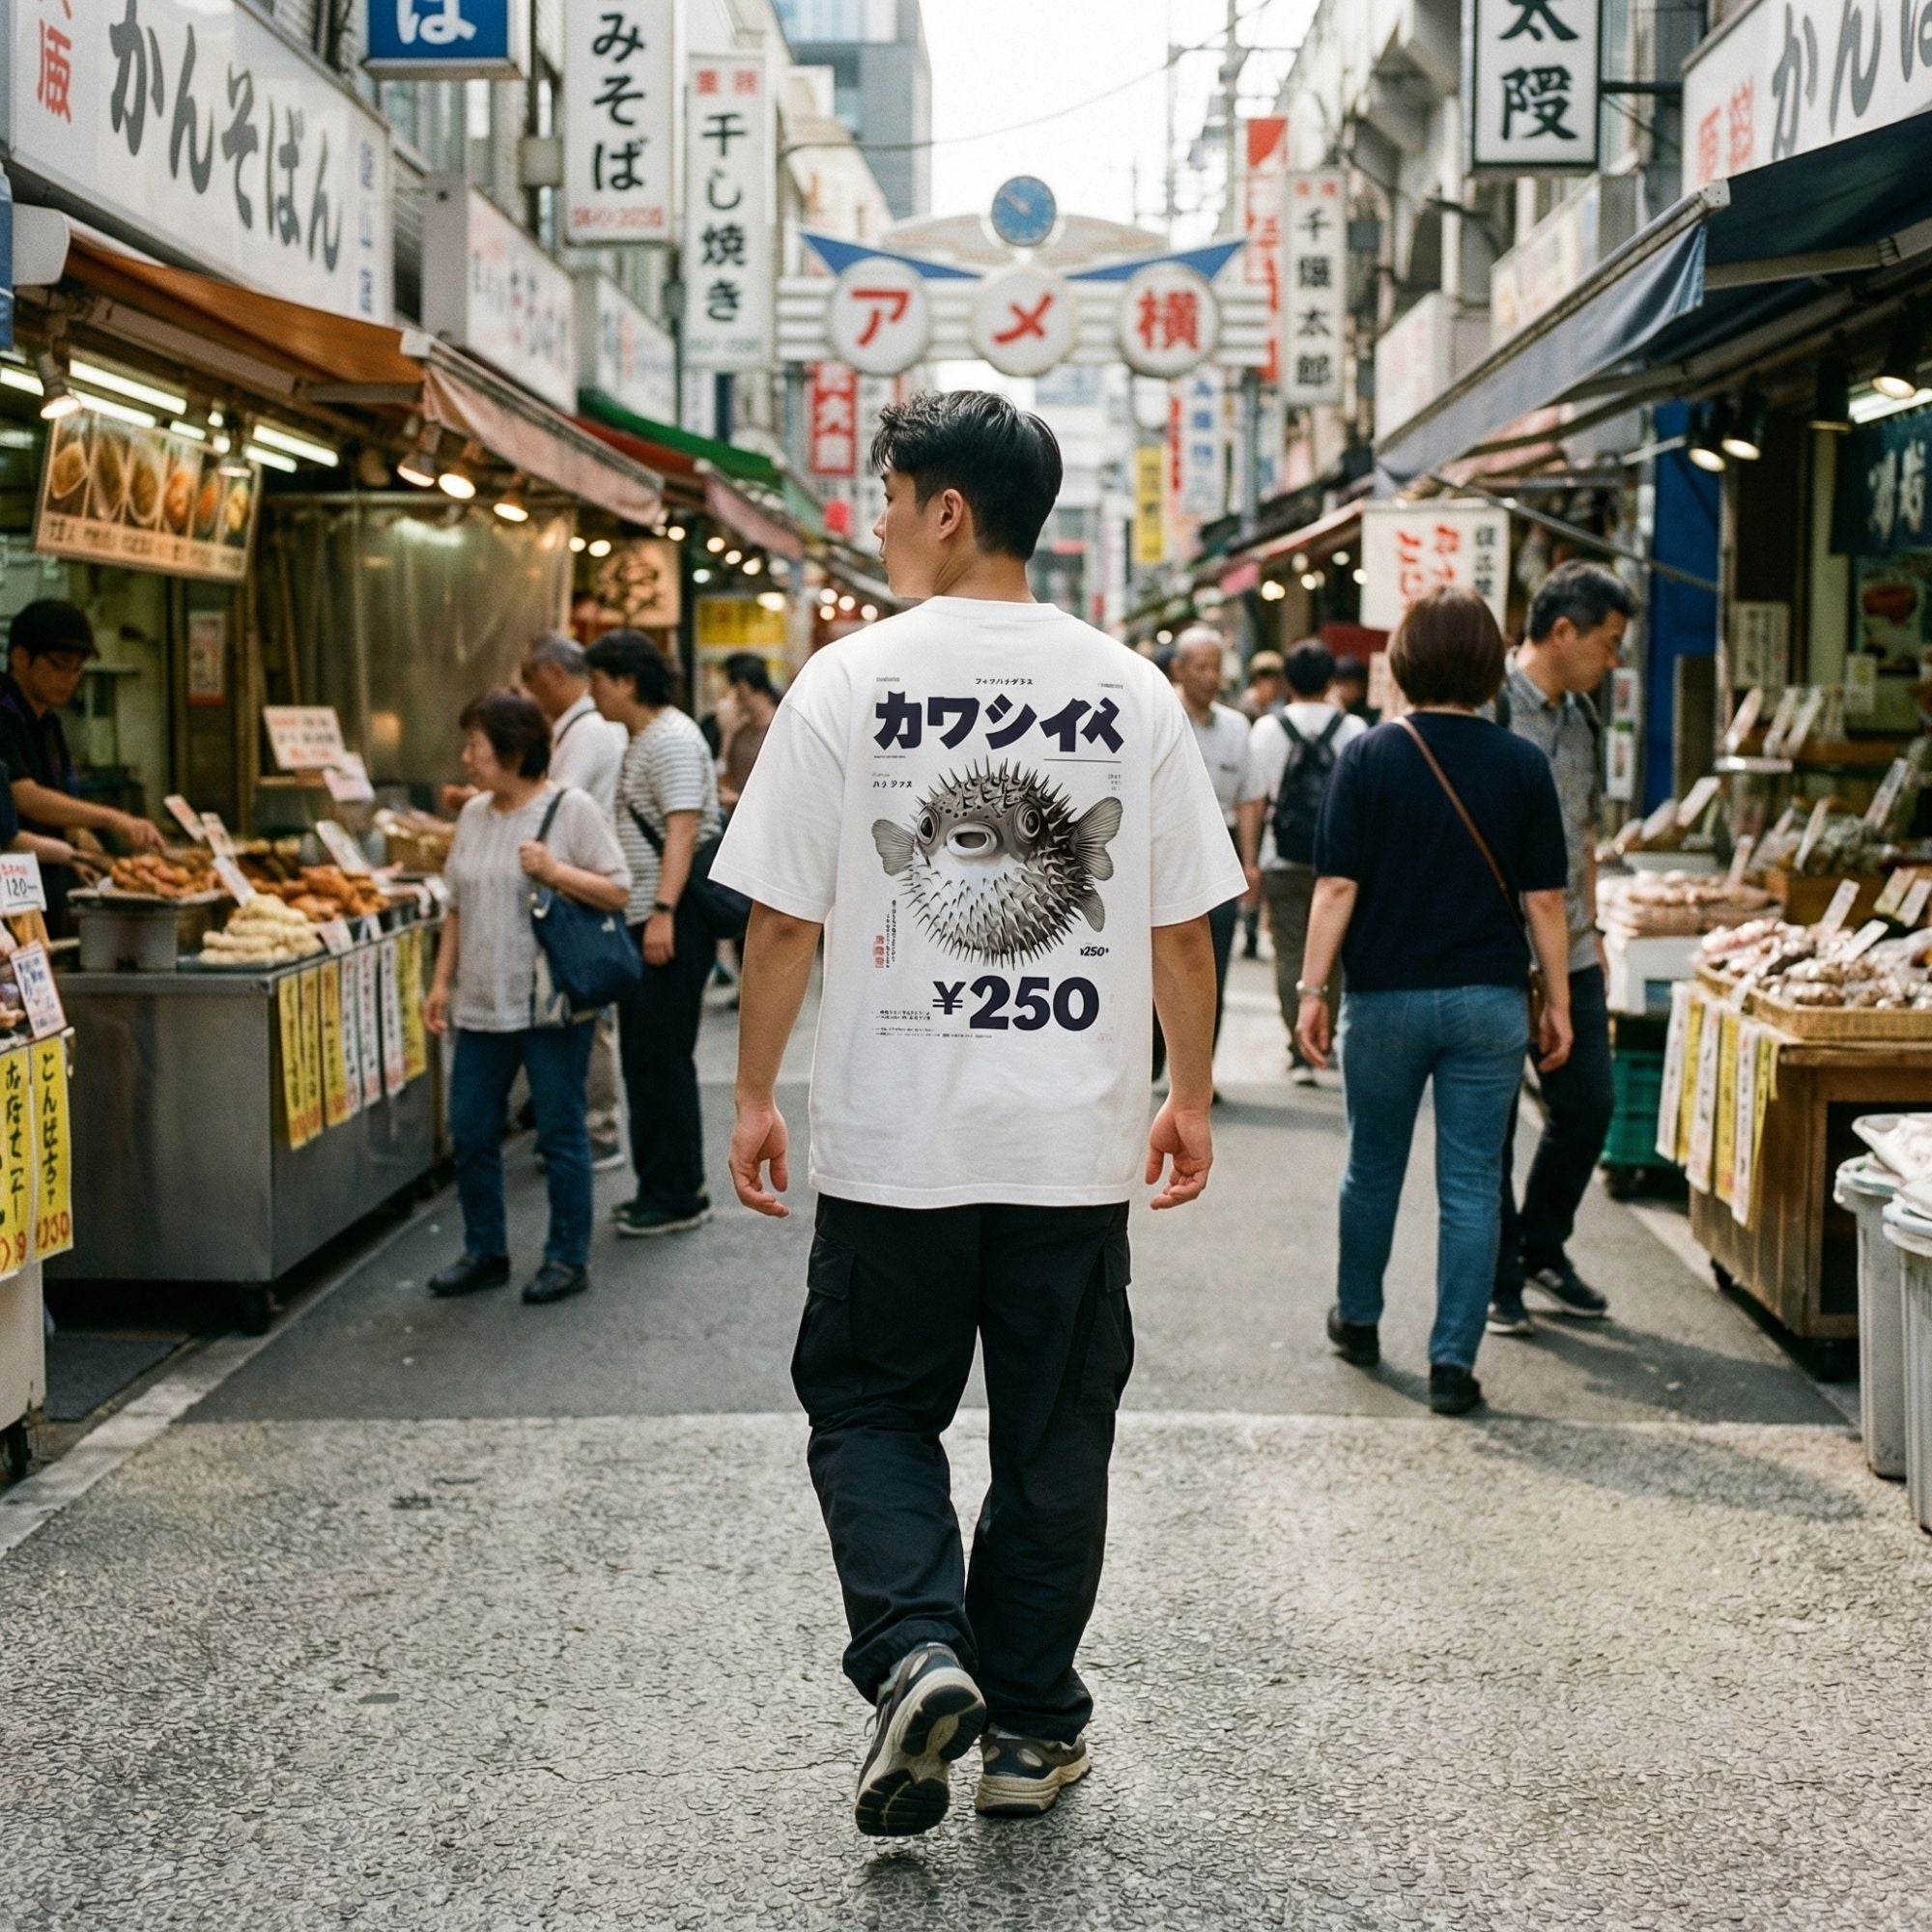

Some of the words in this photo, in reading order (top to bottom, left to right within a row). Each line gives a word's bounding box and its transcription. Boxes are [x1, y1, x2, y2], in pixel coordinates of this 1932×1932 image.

[850, 289, 1200, 352] アメ横
[932, 975, 1099, 1031] ¥250
